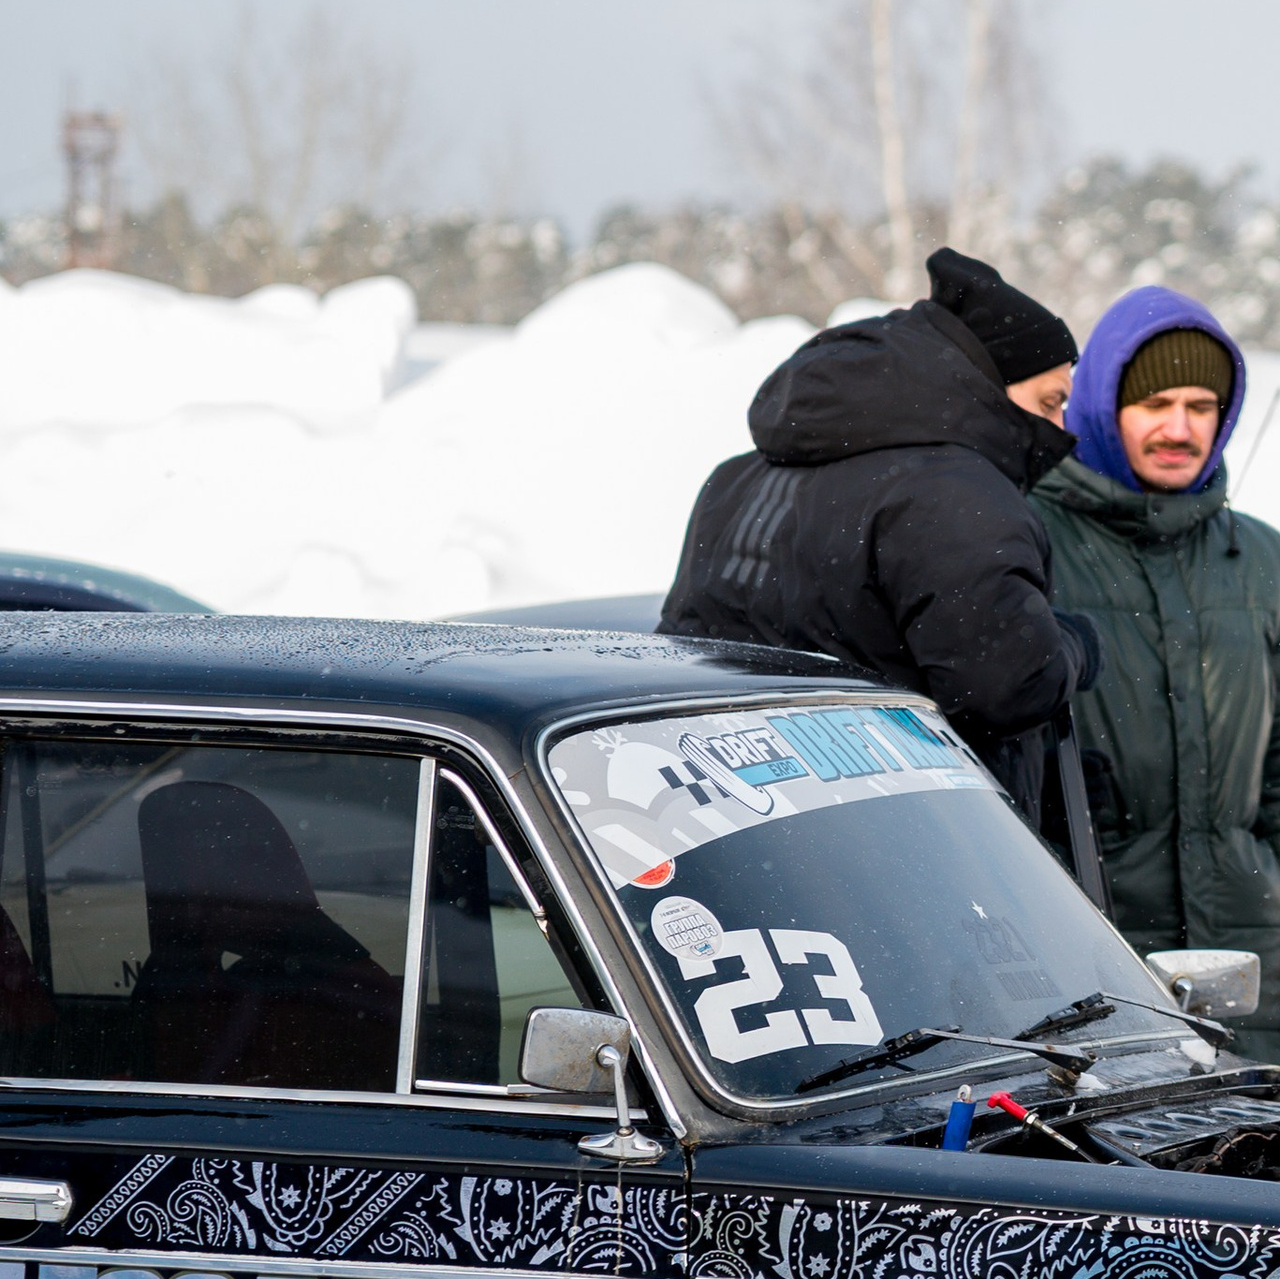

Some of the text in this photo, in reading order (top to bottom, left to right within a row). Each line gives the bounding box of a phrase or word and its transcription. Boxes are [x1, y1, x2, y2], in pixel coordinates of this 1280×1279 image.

[707, 728, 788, 770] DRIFT
[765, 707, 904, 782] DRIFT
[769, 759, 798, 778] EXPO
[663, 913, 706, 935] ГРУППА
[665, 923, 718, 949] ПАРОВОЗ
[678, 927, 884, 1063] 23
